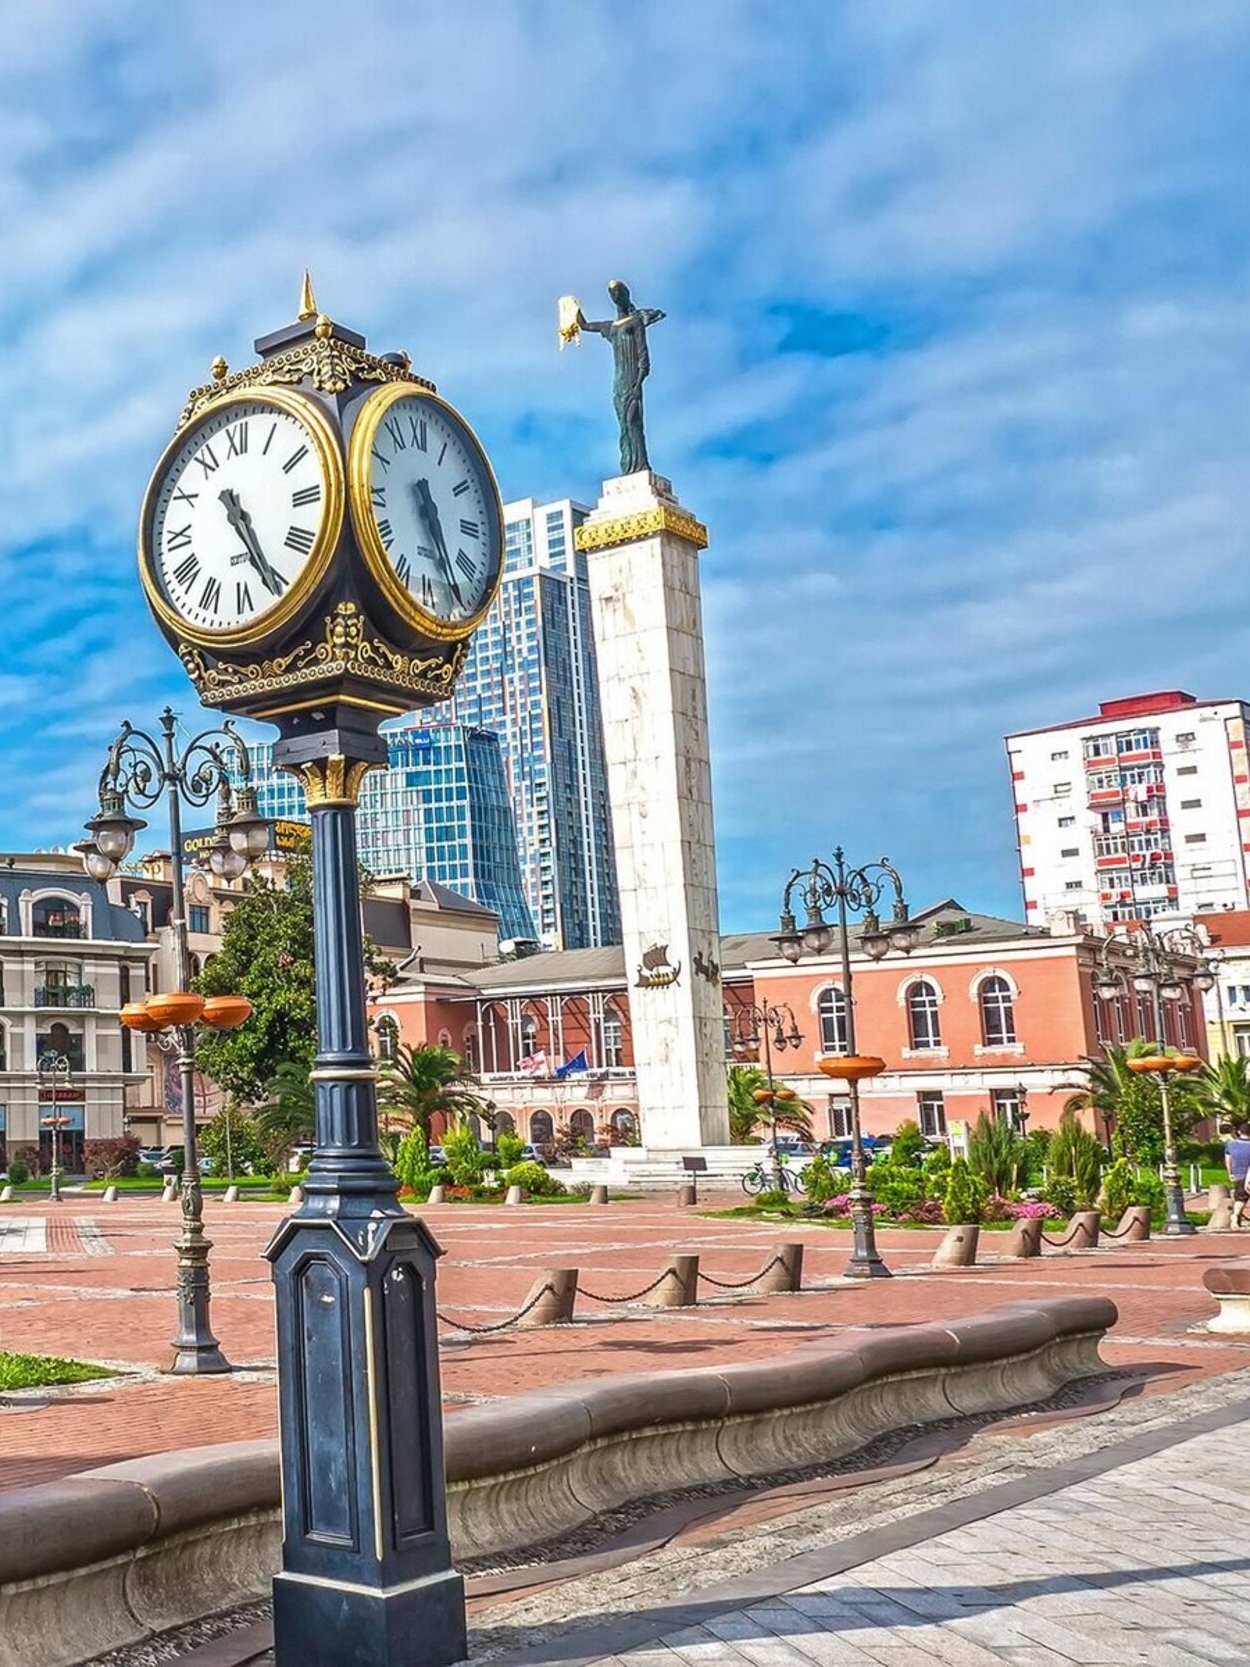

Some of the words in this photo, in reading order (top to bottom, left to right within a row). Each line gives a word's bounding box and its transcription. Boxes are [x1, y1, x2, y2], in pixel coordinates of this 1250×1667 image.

[226, 420, 248, 460] XII
[262, 422, 277, 456] I
[409, 416, 427, 452] XII
[282, 444, 309, 474] II
[173, 486, 199, 508] X
[292, 484, 320, 508] III
[284, 526, 316, 555] IIII
[460, 518, 480, 540] III
[454, 548, 478, 583] IIII
